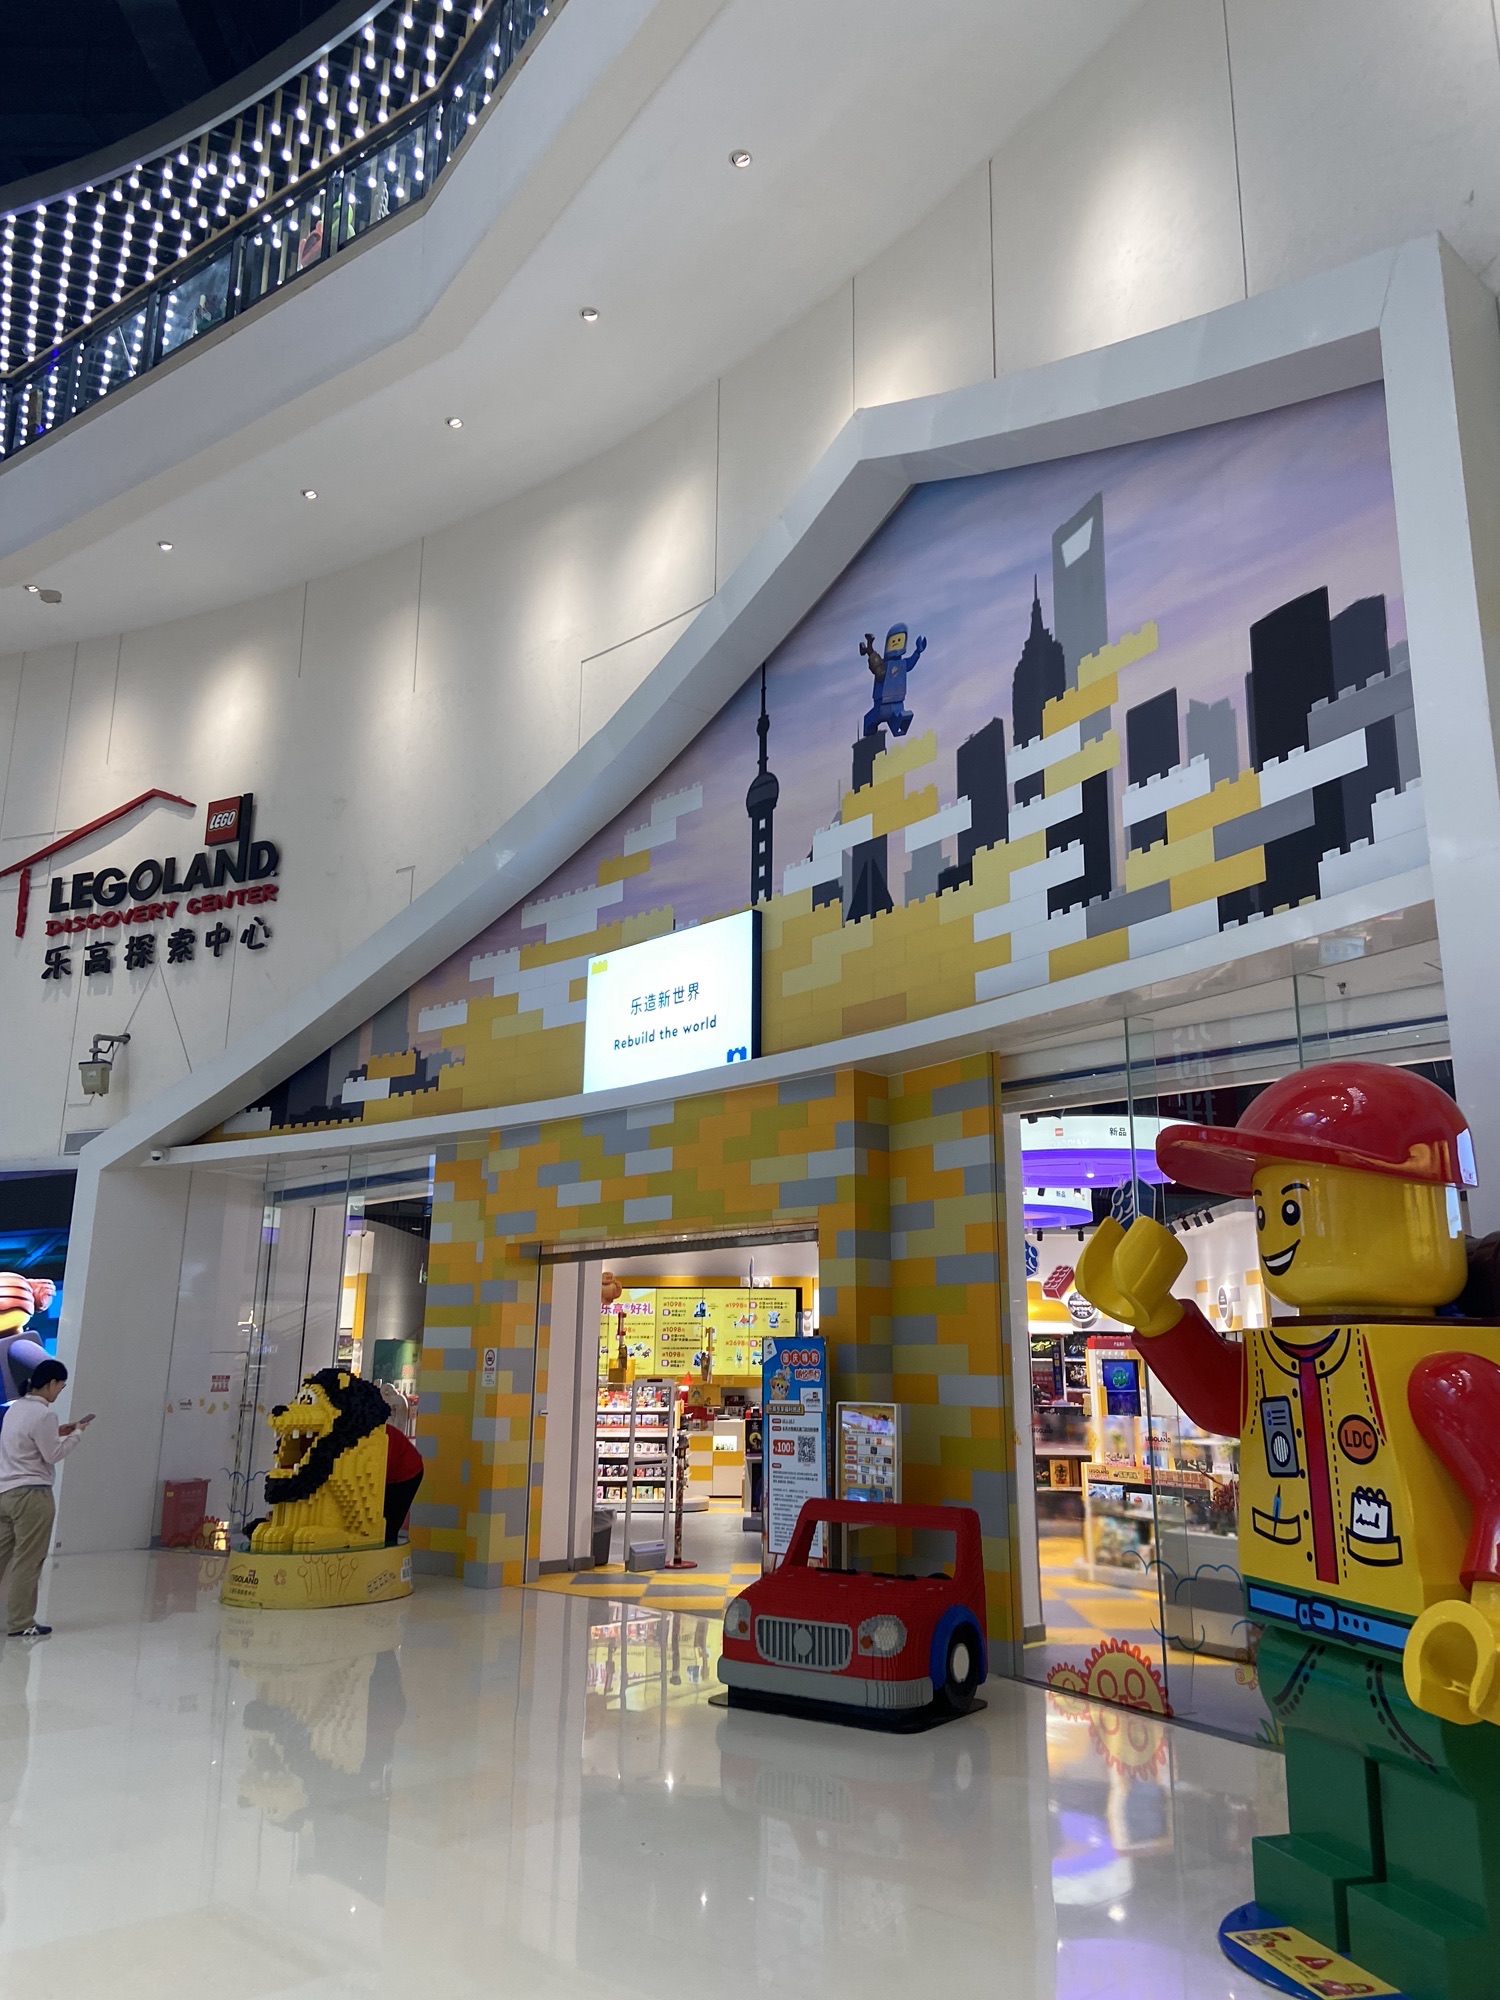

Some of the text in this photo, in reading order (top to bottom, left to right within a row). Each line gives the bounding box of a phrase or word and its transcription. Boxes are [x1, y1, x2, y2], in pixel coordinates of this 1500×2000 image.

[209, 810, 236, 830] LEGO
[49, 839, 279, 913] LEGOLAND
[45, 883, 279, 937] DISCOVERY CENTER
[41, 916, 273, 980] 乐高探索中心
[630, 981, 700, 1016] 乐造新世界
[613, 1014, 717, 1050] Rebuild the world
[1109, 1127, 1127, 1137] 新品
[1344, 1429, 1373, 1449] LDC
